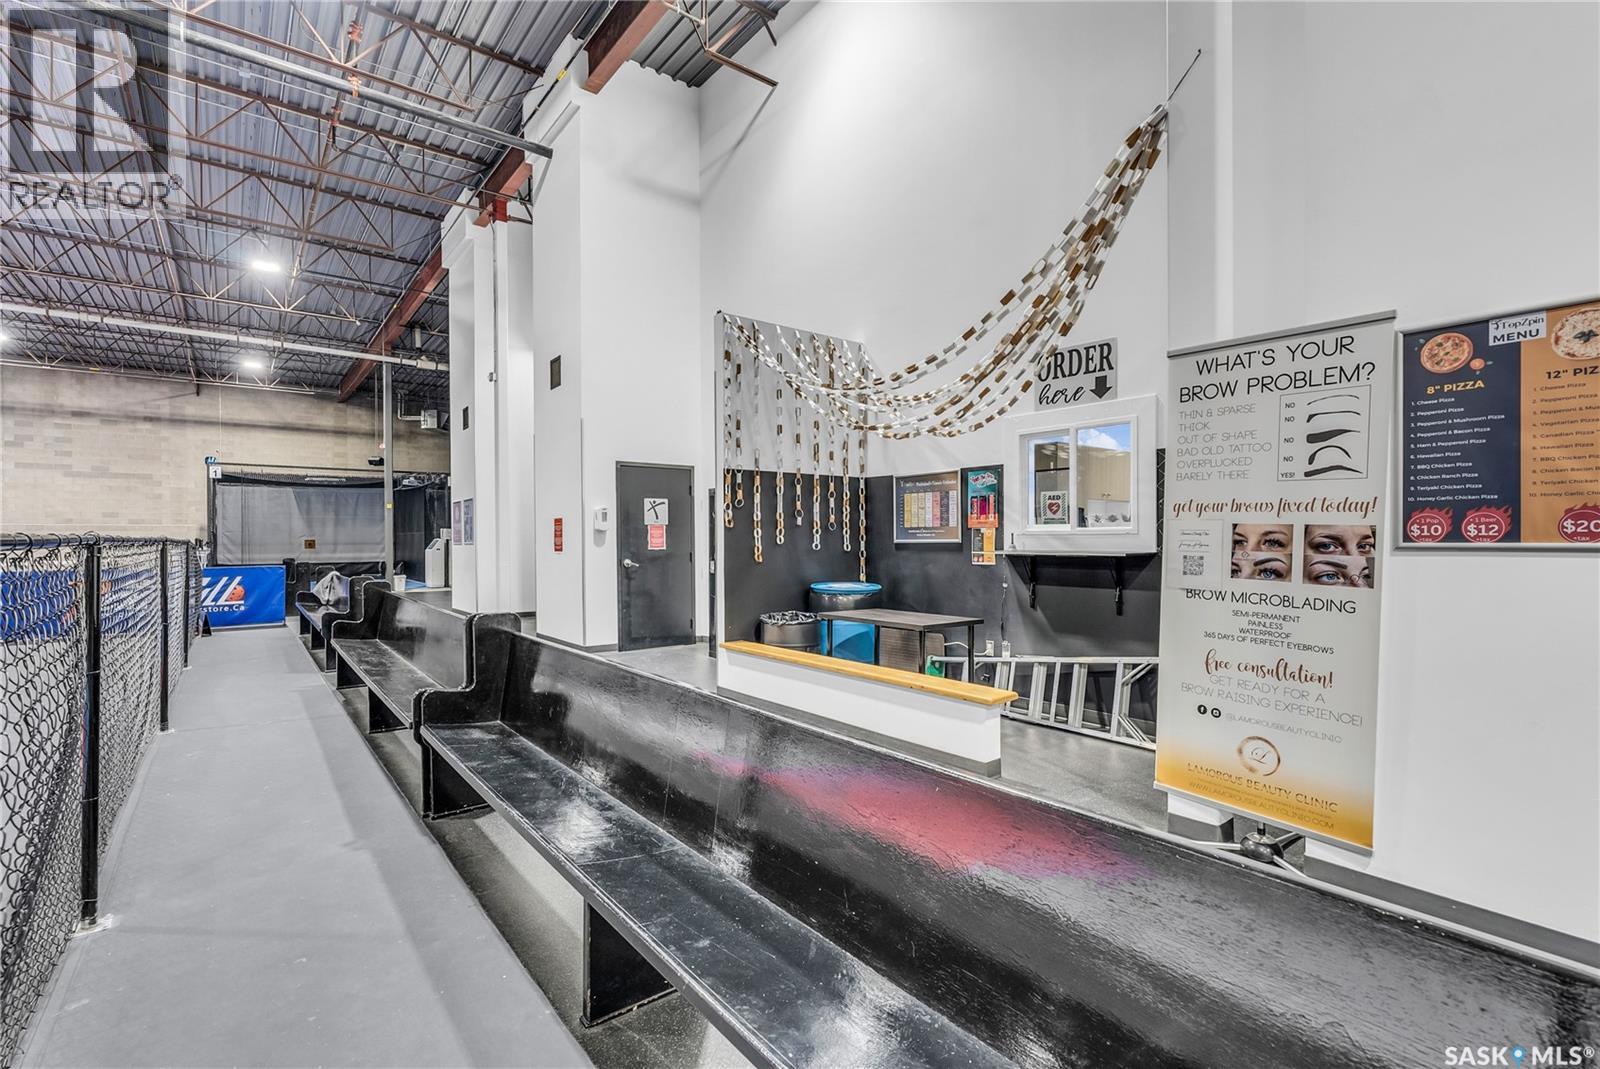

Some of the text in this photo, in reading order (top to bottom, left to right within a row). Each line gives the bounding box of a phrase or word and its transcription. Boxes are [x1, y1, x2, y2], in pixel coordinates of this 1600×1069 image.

[1493, 328, 1539, 343] MENU
[1037, 343, 1114, 382] ORDER
[1196, 335, 1355, 376] WHAT'S YOUR
[1179, 361, 1376, 403] BROW PROBLEM?
[1444, 380, 1485, 392] PIZZA
[1039, 383, 1086, 405] here
[1179, 409, 1203, 420] THIN
[1217, 403, 1256, 416] SPARSE
[1416, 408, 1447, 416] Pepperoni
[1179, 421, 1210, 432] THICK
[1177, 430, 1257, 444] OUT OF SHAPE
[1437, 439, 1469, 447] Pepperoni
[1177, 442, 1272, 457] BAD OLD TATTOO
[1176, 457, 1253, 469] OVERPLUCKED
[1176, 469, 1249, 481] BARELY THERE
[1173, 496, 1378, 519] get your brows fixed today!
[1410, 523, 1442, 537] $10
[1467, 523, 1499, 537] $12
[1185, 588, 1357, 614] BROW MICROBLADING
[1231, 609, 1301, 623] SEMI-PERMANENT
[1247, 620, 1284, 630] PAINLESS
[1238, 627, 1292, 640] WATERPROOF
[1203, 632, 1335, 655] 365 DAYS OF PERFECT EYEBROWS
[1205, 648, 1334, 689] free consultation!
[1209, 674, 1326, 704] GET READY FOR A
[1181, 682, 1363, 728] BROW RAISING EXPERIENCE!
[1246, 778, 1292, 799] BEAUTY
[1295, 793, 1338, 813] CLINIC
